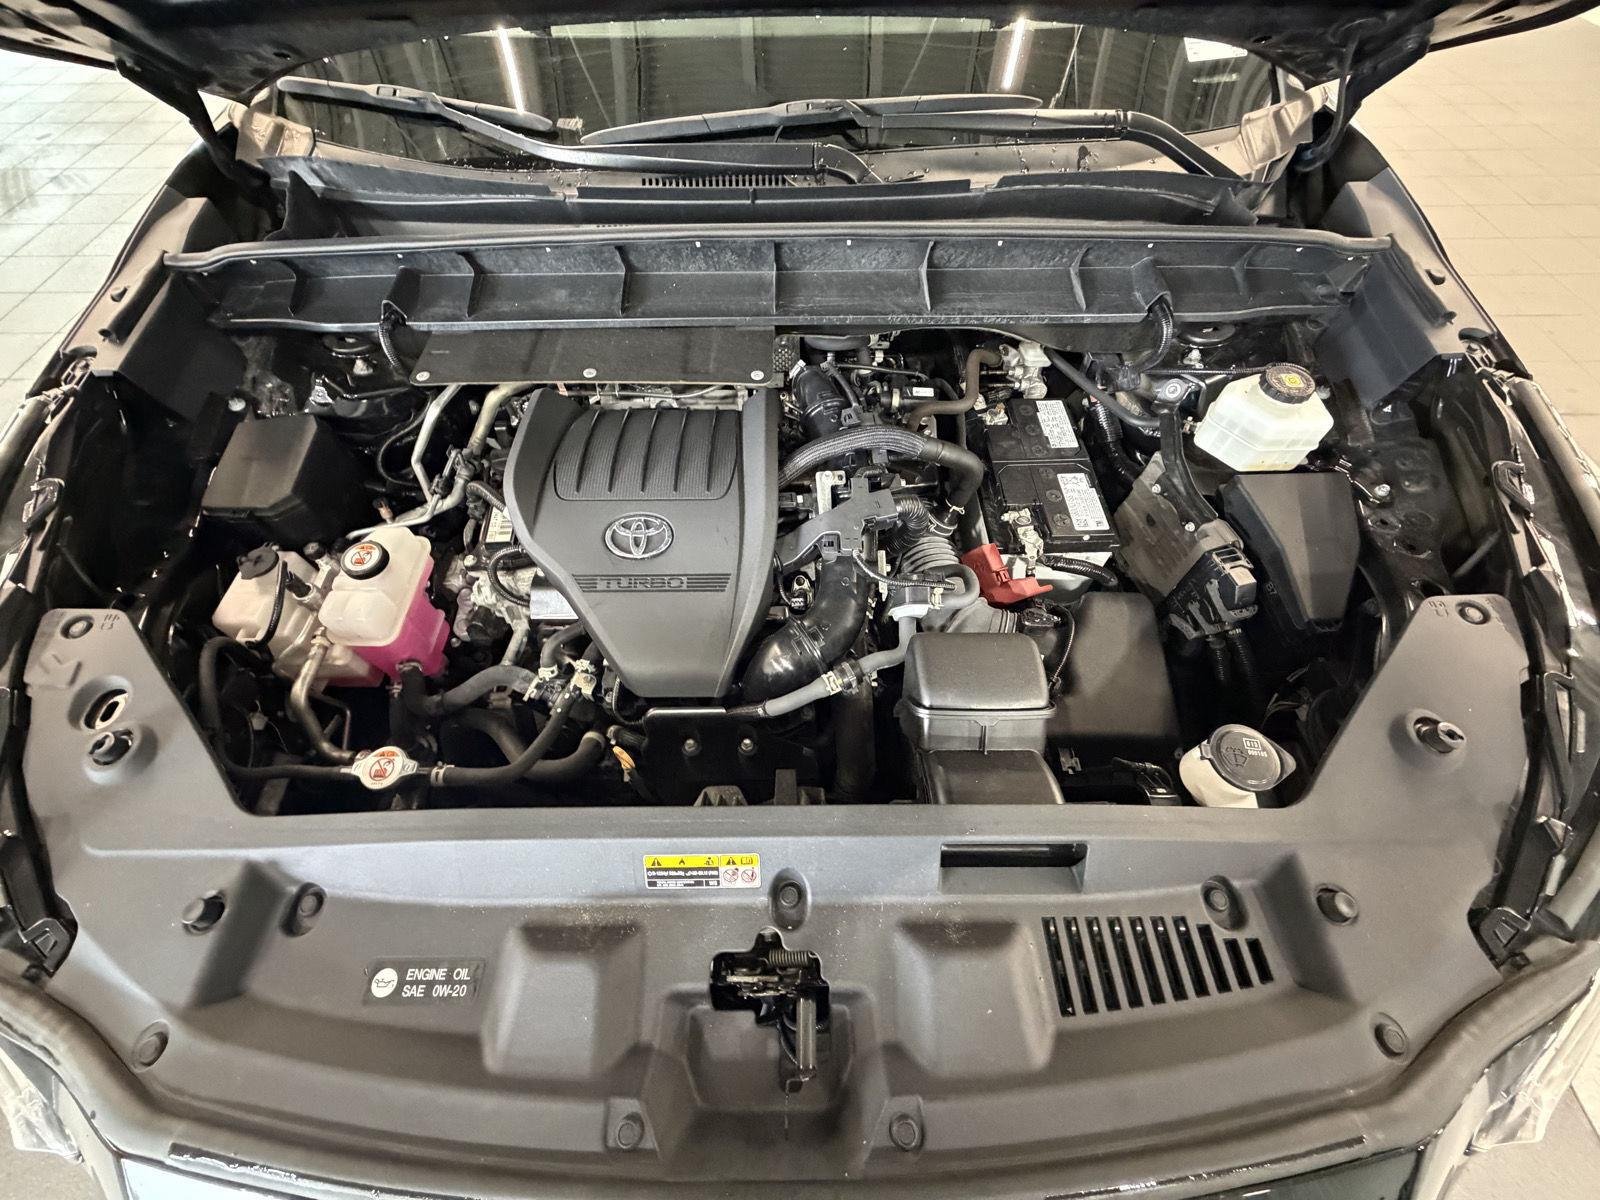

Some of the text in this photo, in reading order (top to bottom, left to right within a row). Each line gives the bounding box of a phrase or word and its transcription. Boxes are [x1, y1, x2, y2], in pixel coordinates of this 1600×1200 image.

[599, 577, 685, 589] TURBO
[406, 968, 471, 981] ENGINE OIL
[401, 984, 468, 998] SAE 0W-20
